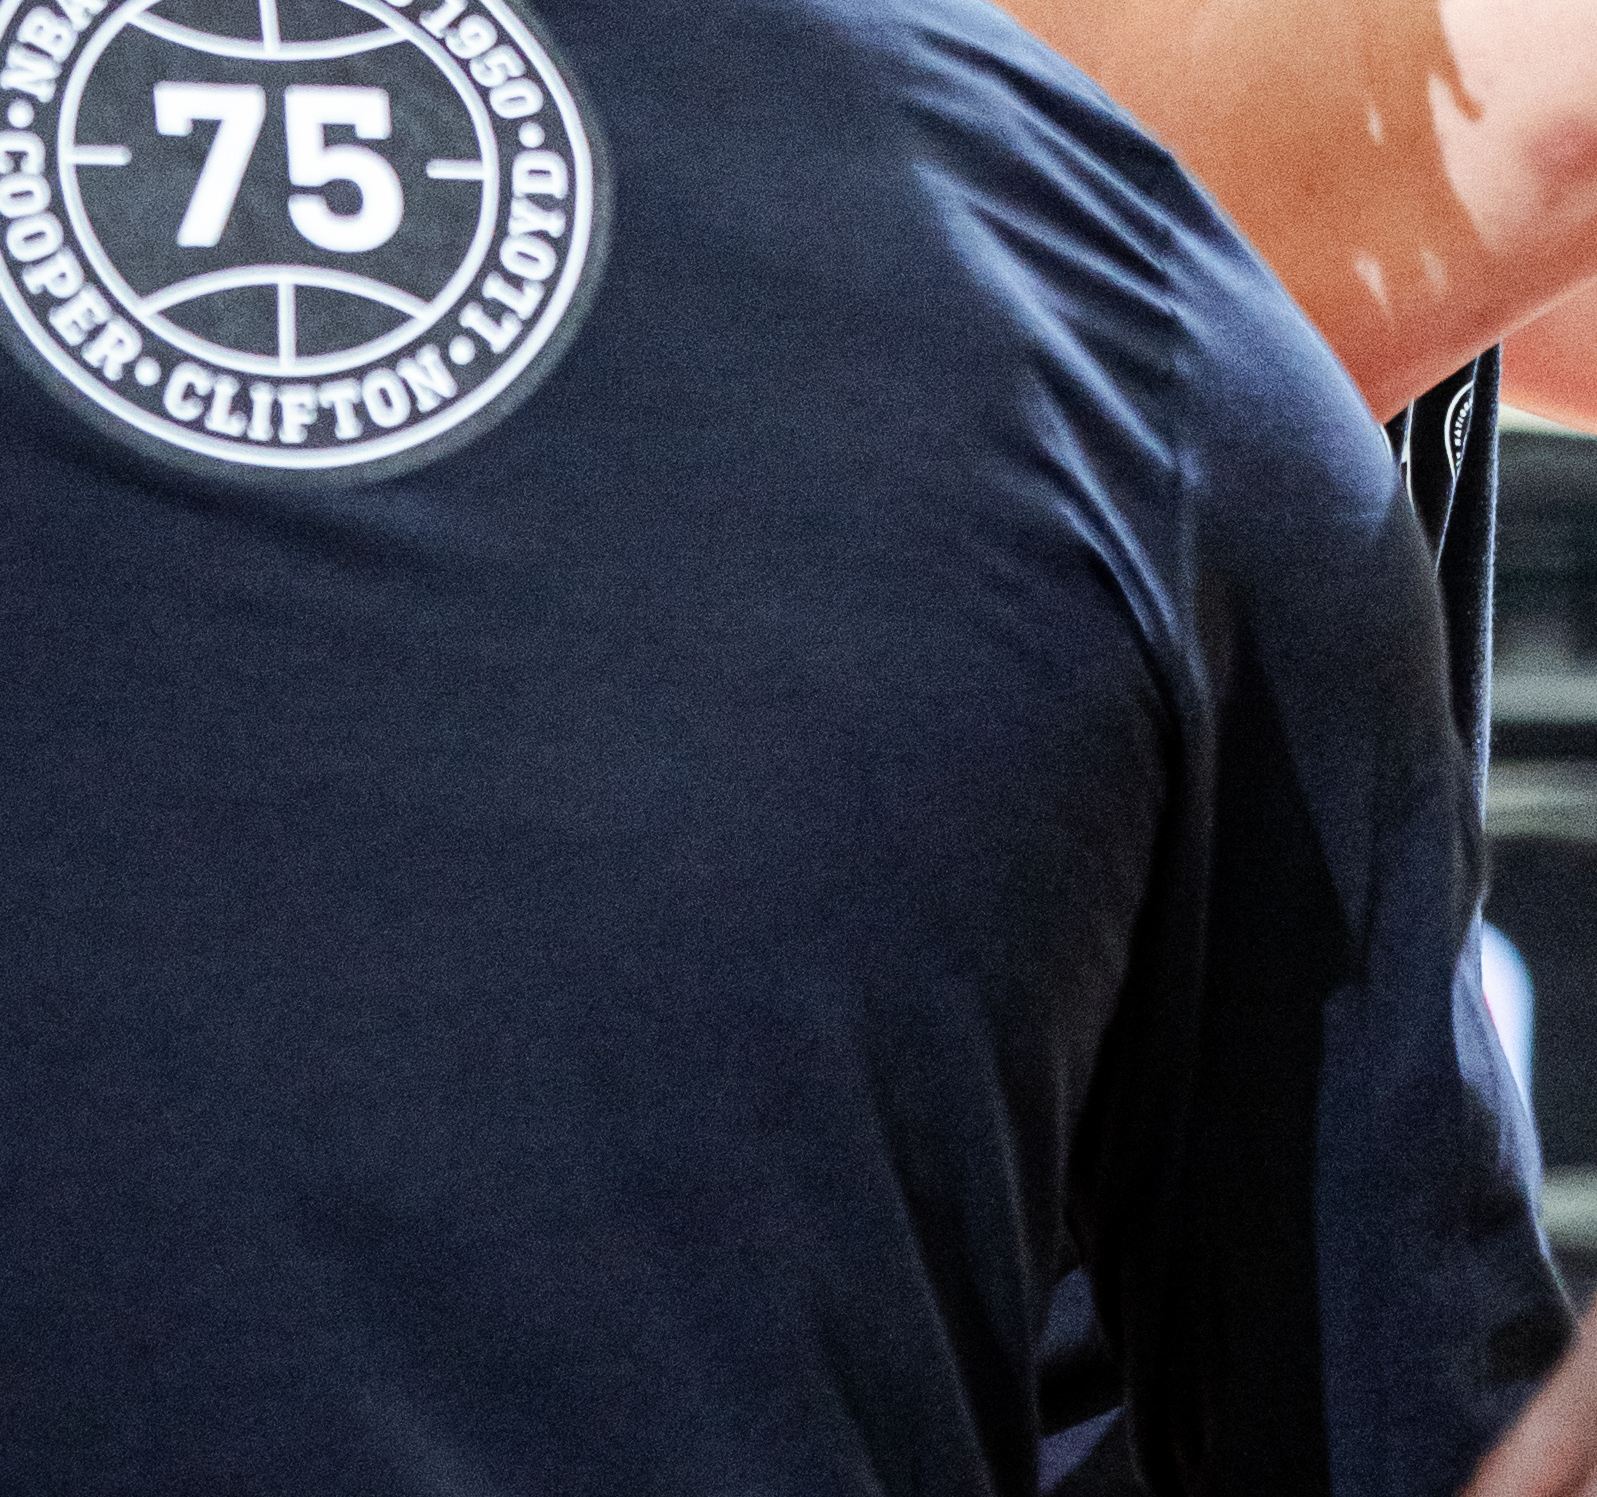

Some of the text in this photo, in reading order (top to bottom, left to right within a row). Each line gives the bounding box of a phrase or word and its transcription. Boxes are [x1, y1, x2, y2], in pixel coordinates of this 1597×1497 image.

[0, 128, 569, 444] COOPER CLIFTON LLOYD
[153, 81, 405, 253] 75
